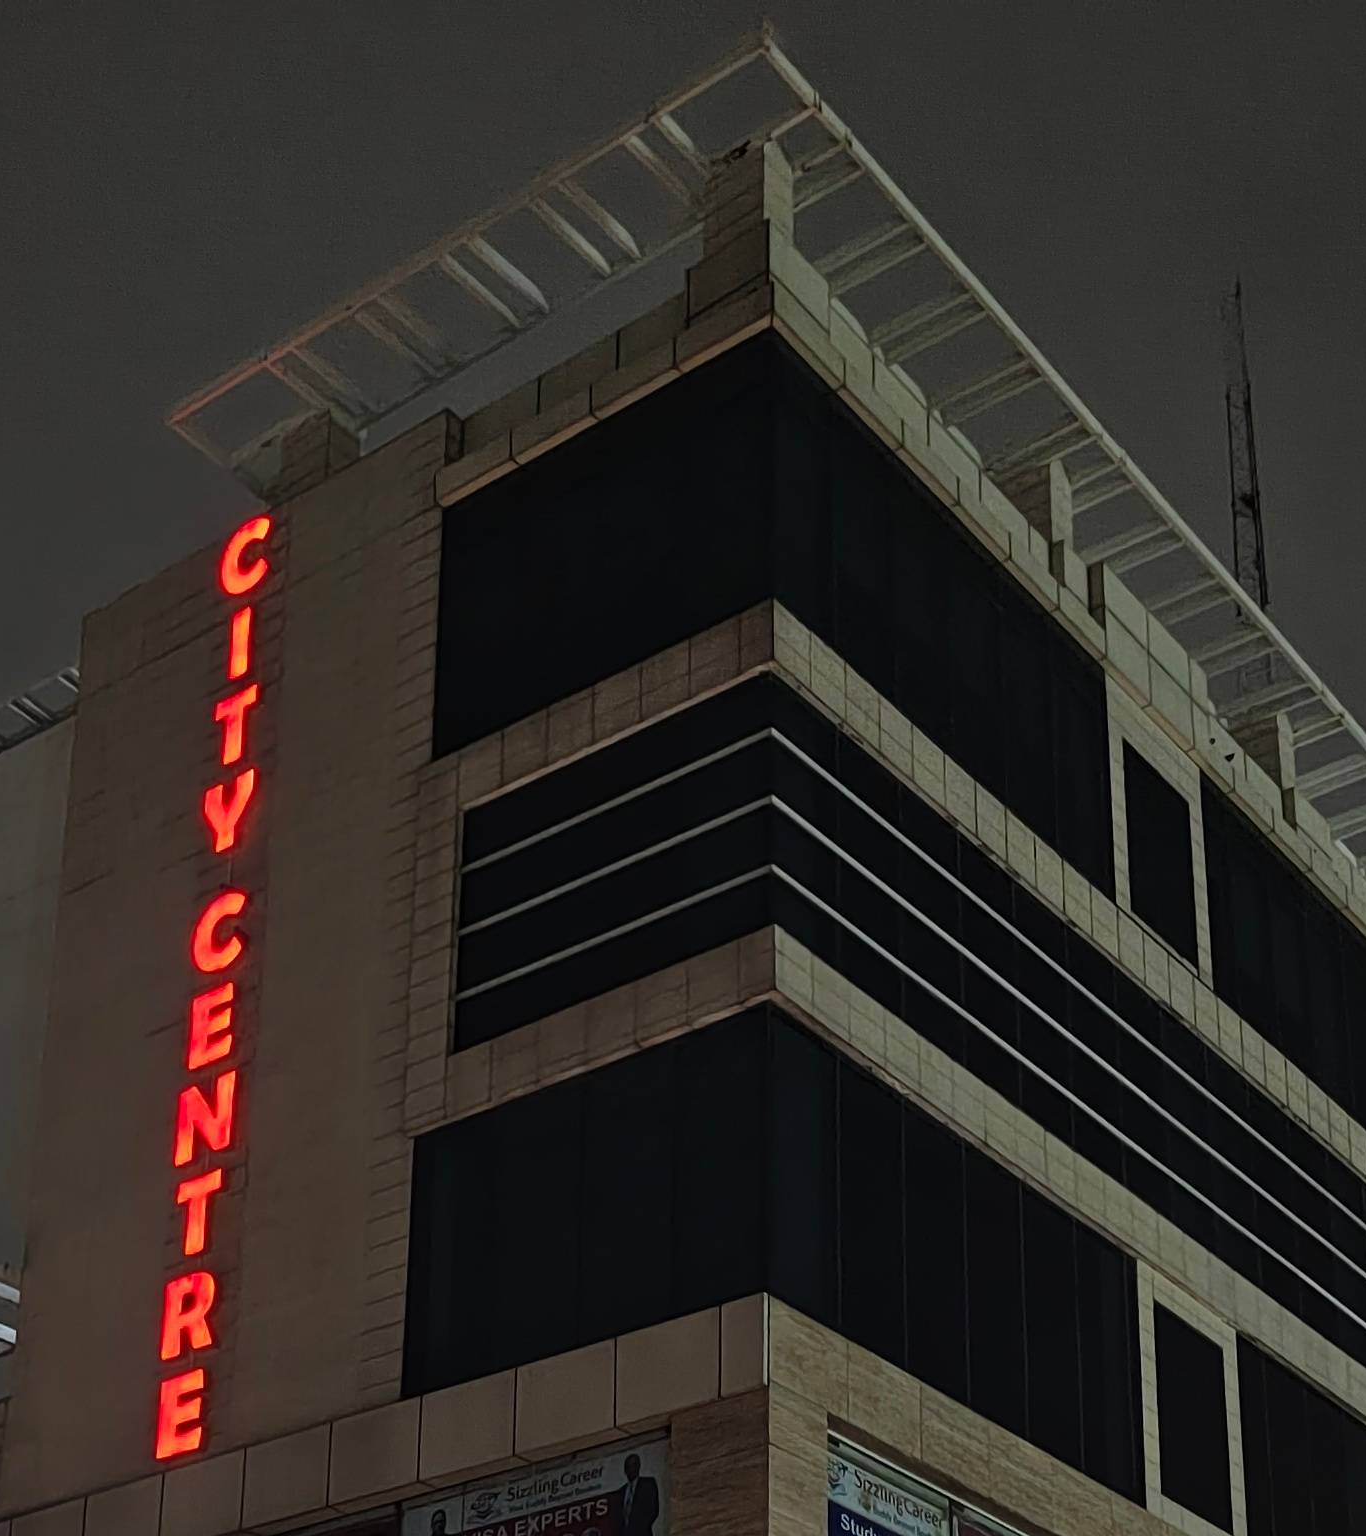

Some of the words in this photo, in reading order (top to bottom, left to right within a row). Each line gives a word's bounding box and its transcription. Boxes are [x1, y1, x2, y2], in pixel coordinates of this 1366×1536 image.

[202, 515, 272, 854] CITY
[155, 890, 246, 1461] CENTRE
[515, 1498, 610, 1536] EXPERTS
